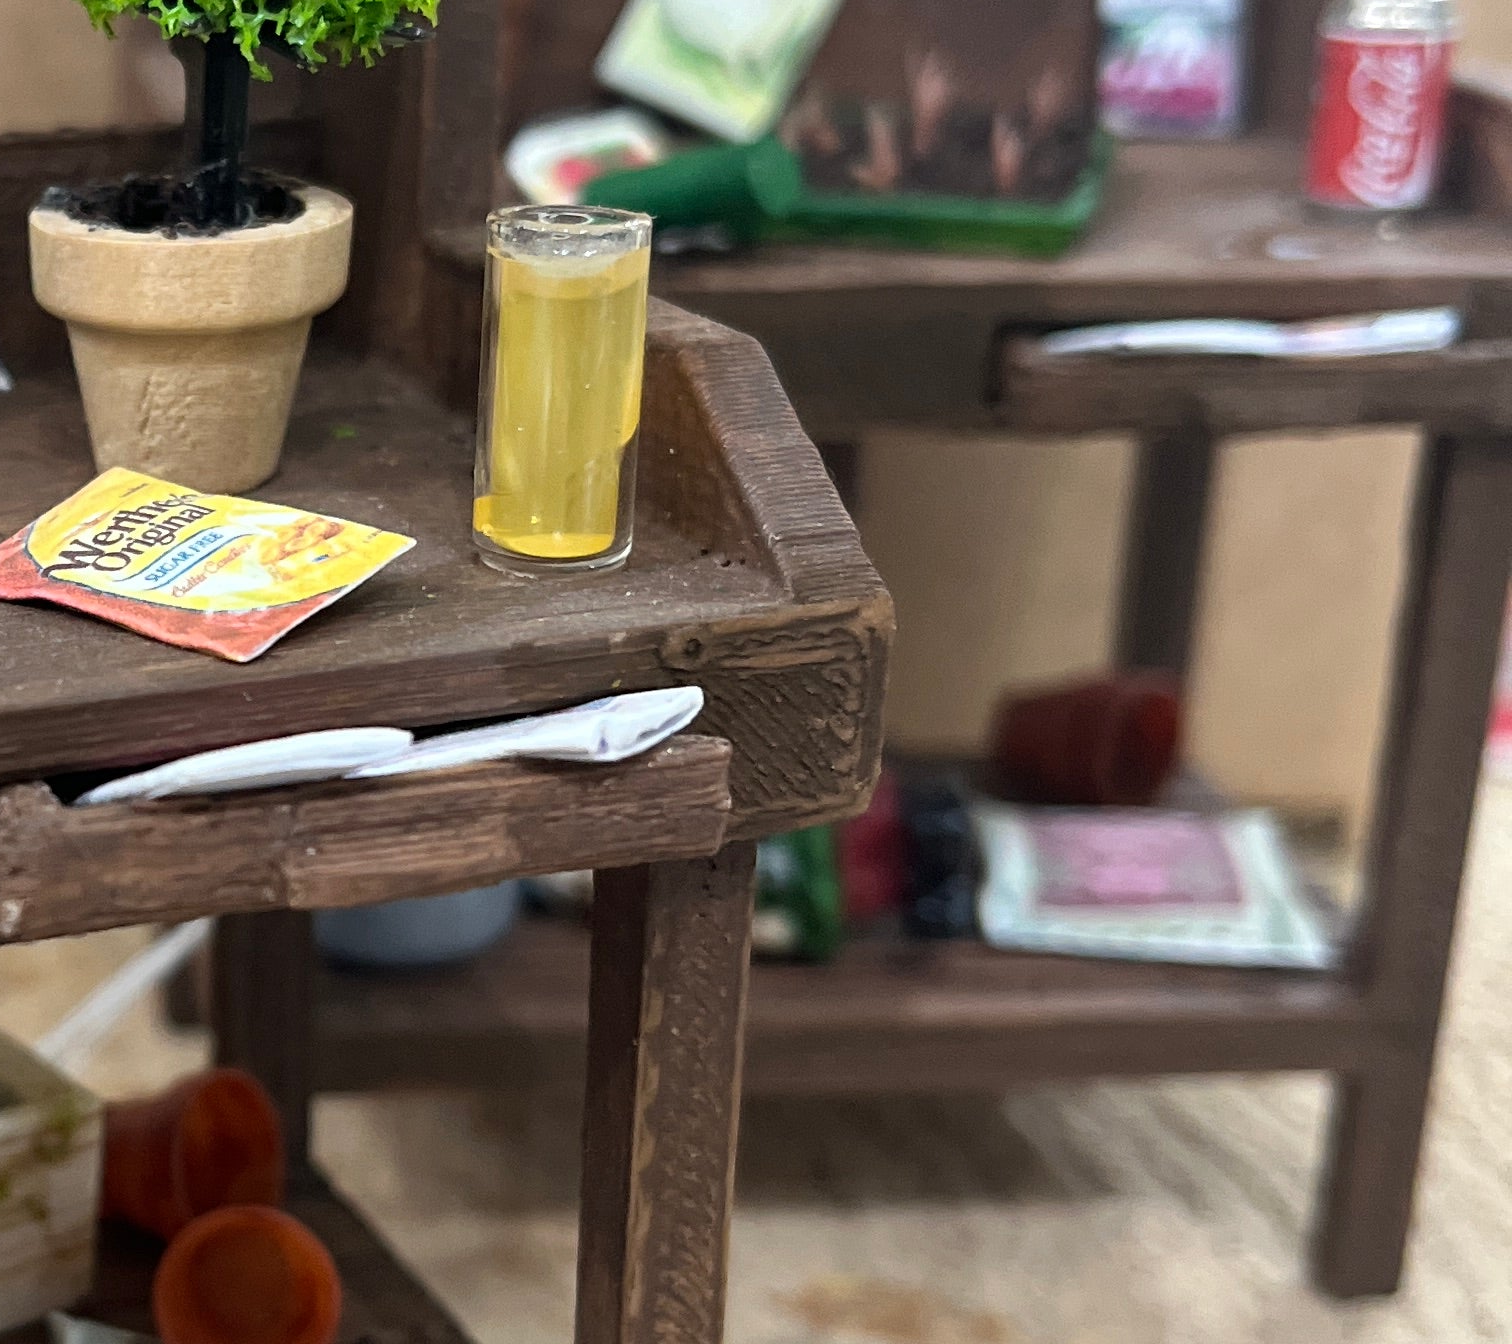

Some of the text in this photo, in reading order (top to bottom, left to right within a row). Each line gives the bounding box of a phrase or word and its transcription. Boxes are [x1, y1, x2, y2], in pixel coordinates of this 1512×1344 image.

[91, 502, 215, 571] Original
[144, 532, 224, 582] SUGAR FREE
